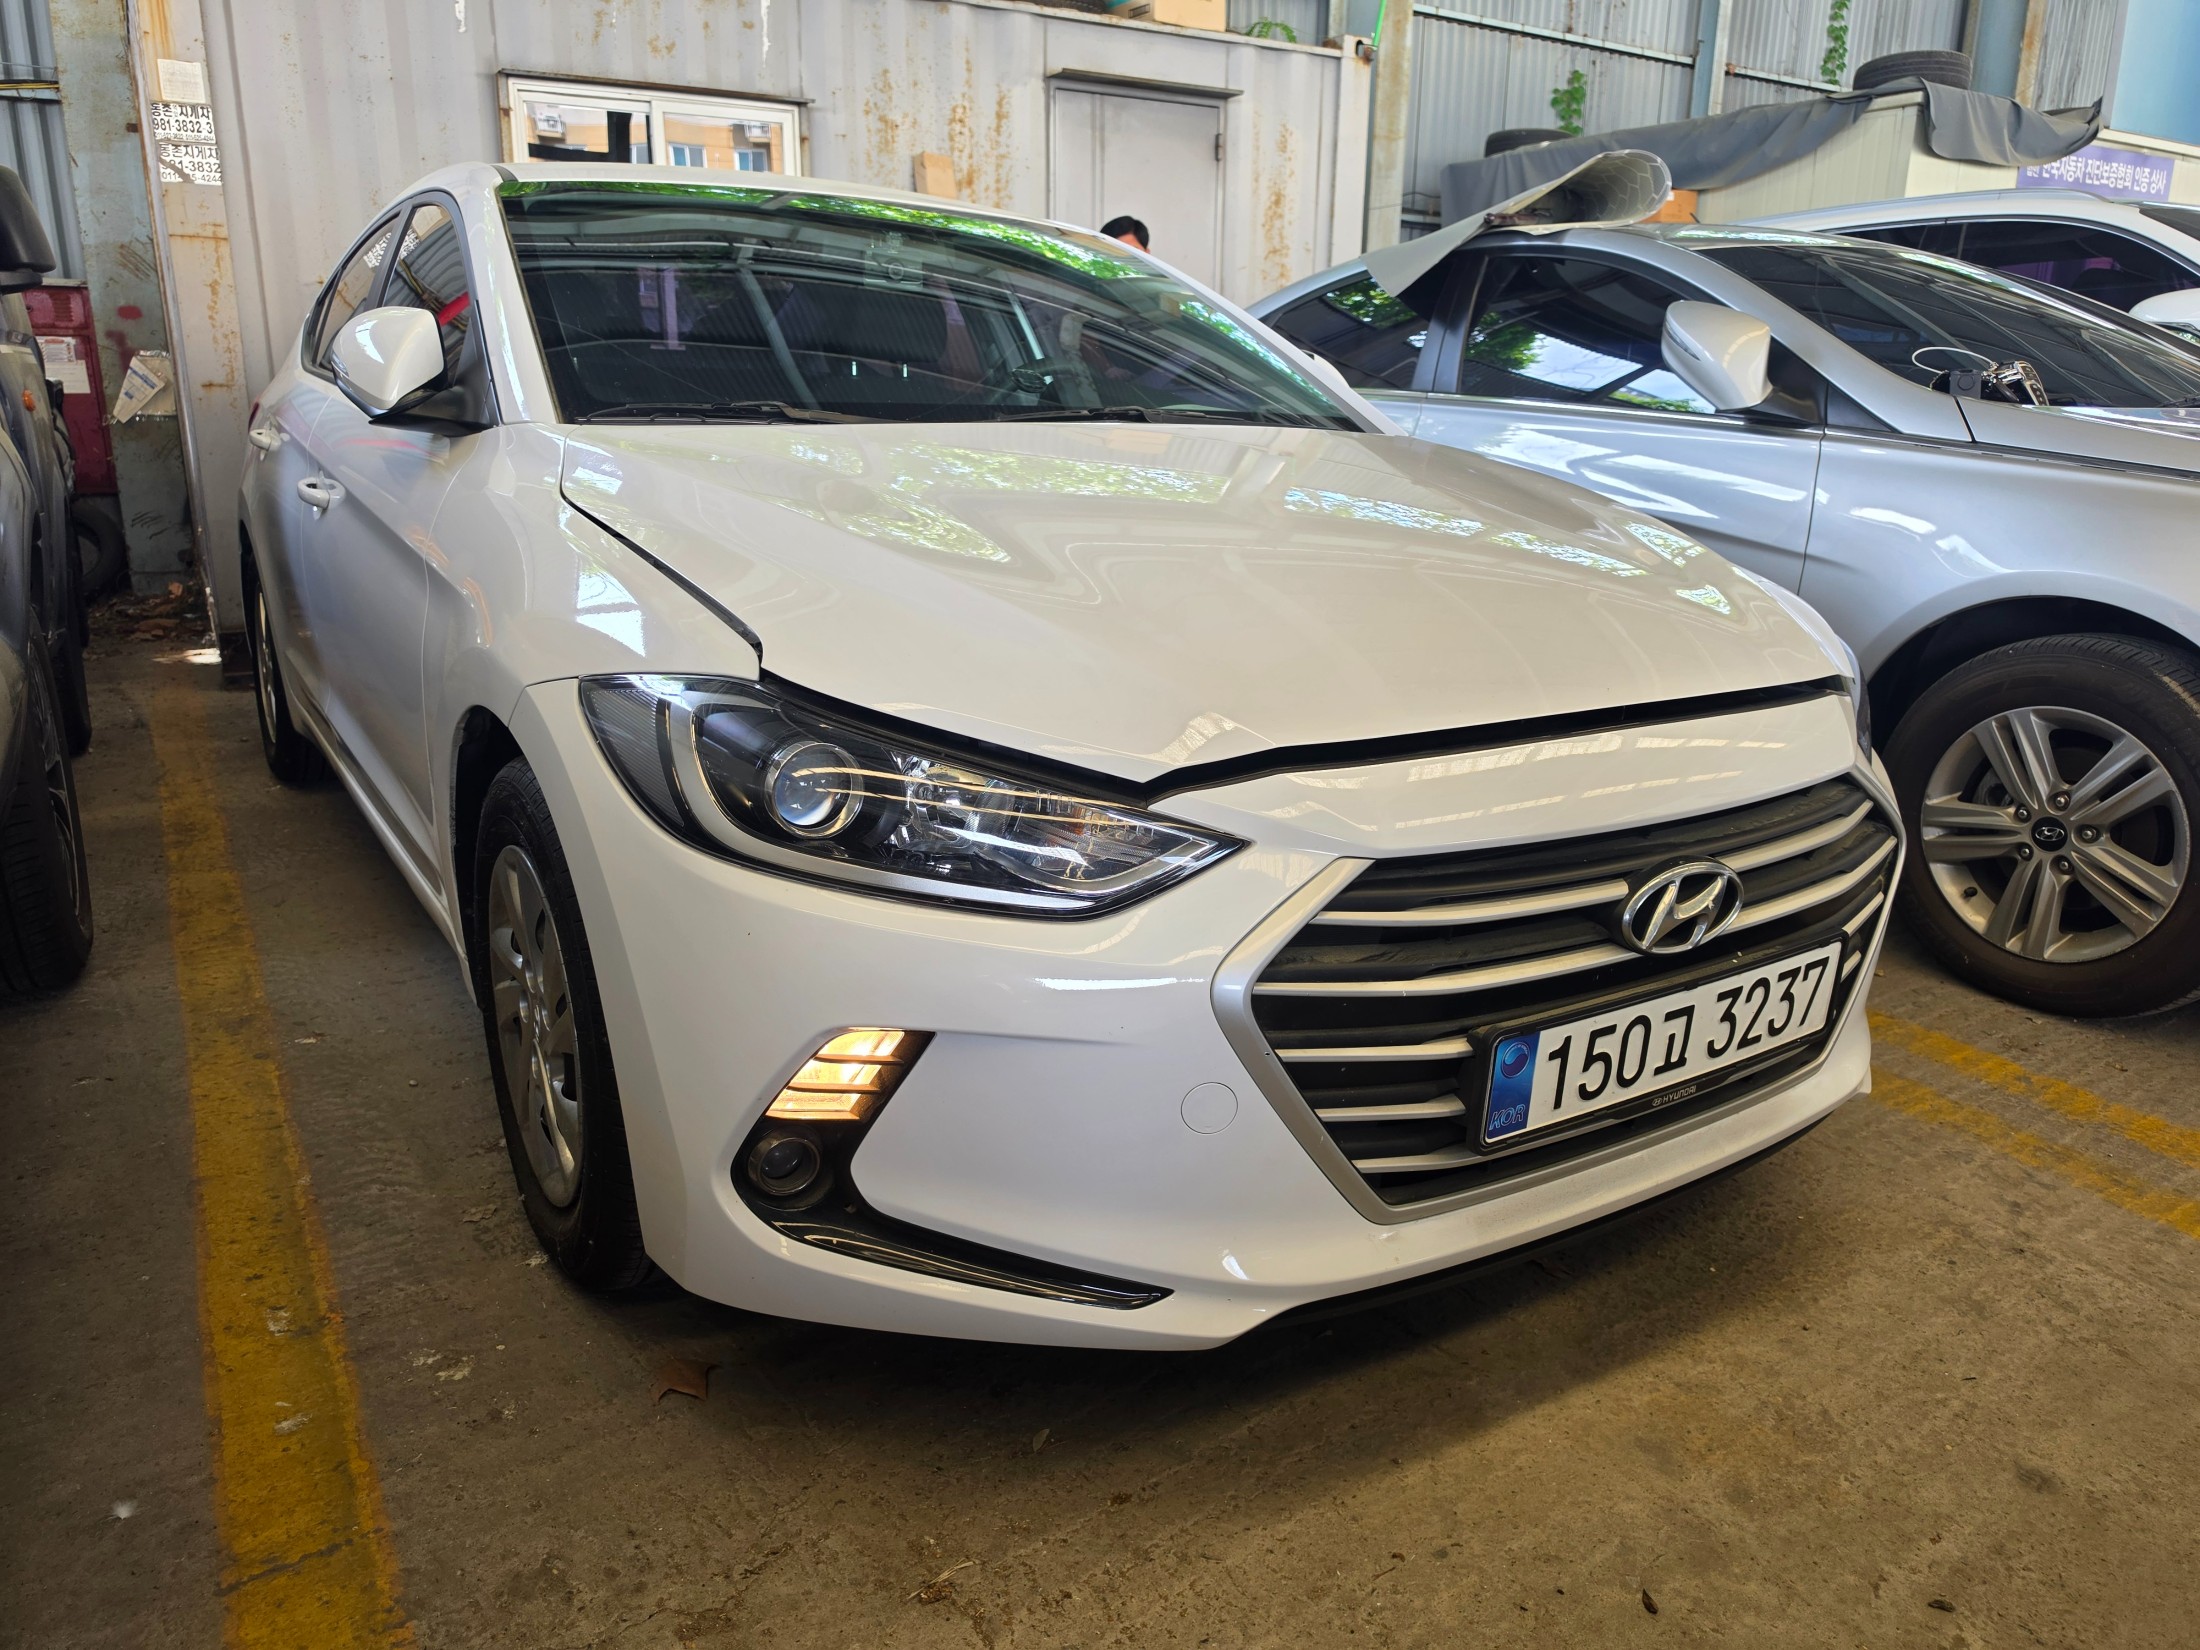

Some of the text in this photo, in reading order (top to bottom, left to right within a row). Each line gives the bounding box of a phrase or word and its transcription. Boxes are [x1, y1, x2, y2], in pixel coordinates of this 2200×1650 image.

[2085, 158, 2134, 190] 진단보증협회
[2133, 166, 2150, 193] 인증
[2150, 168, 2167, 195] 상사
[1707, 956, 1830, 1059] 3237
[1662, 1084, 1697, 1103] HYUNDAI
[1488, 1103, 1526, 1130] KOR
